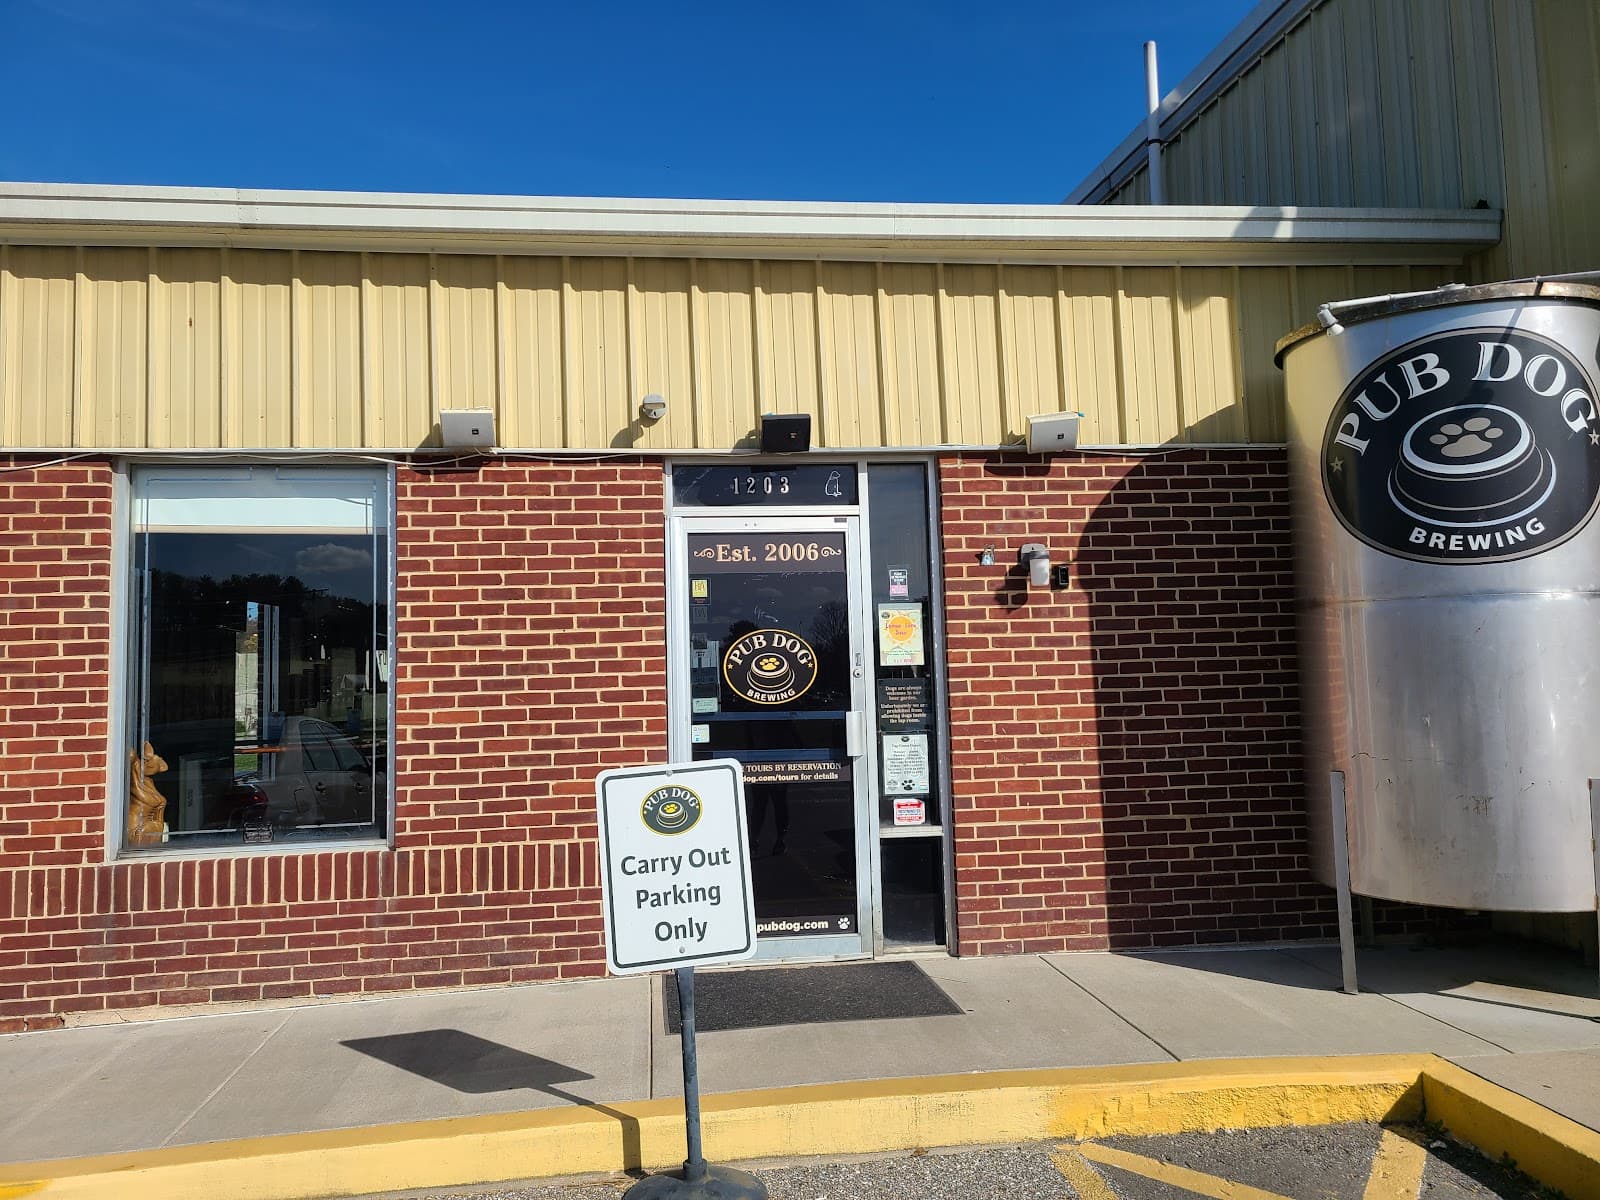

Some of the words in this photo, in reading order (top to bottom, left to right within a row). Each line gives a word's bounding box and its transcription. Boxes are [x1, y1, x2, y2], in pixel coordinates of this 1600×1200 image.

[1333, 352, 1450, 457] PUB
[1471, 341, 1597, 434] DOG
[732, 476, 790, 495] 1203
[1408, 516, 1547, 551] BREWING
[715, 543, 757, 562] Est.
[764, 542, 819, 562] 2006
[729, 634, 767, 666] PUB
[772, 633, 813, 664] DOG
[746, 688, 796, 702] BREWING
[746, 764, 774, 772] TOURS
[775, 764, 786, 772] BY
[787, 762, 842, 772] RESERVATION
[800, 773, 812, 781] for
[814, 772, 839, 780] details
[644, 789, 668, 811] PUB
[671, 787, 699, 807] DOG
[620, 855, 683, 876] Carry
[688, 847, 732, 869] Out
[636, 882, 721, 910] Parking
[654, 917, 708, 942] Only
[756, 920, 829, 934] pubdog.com
